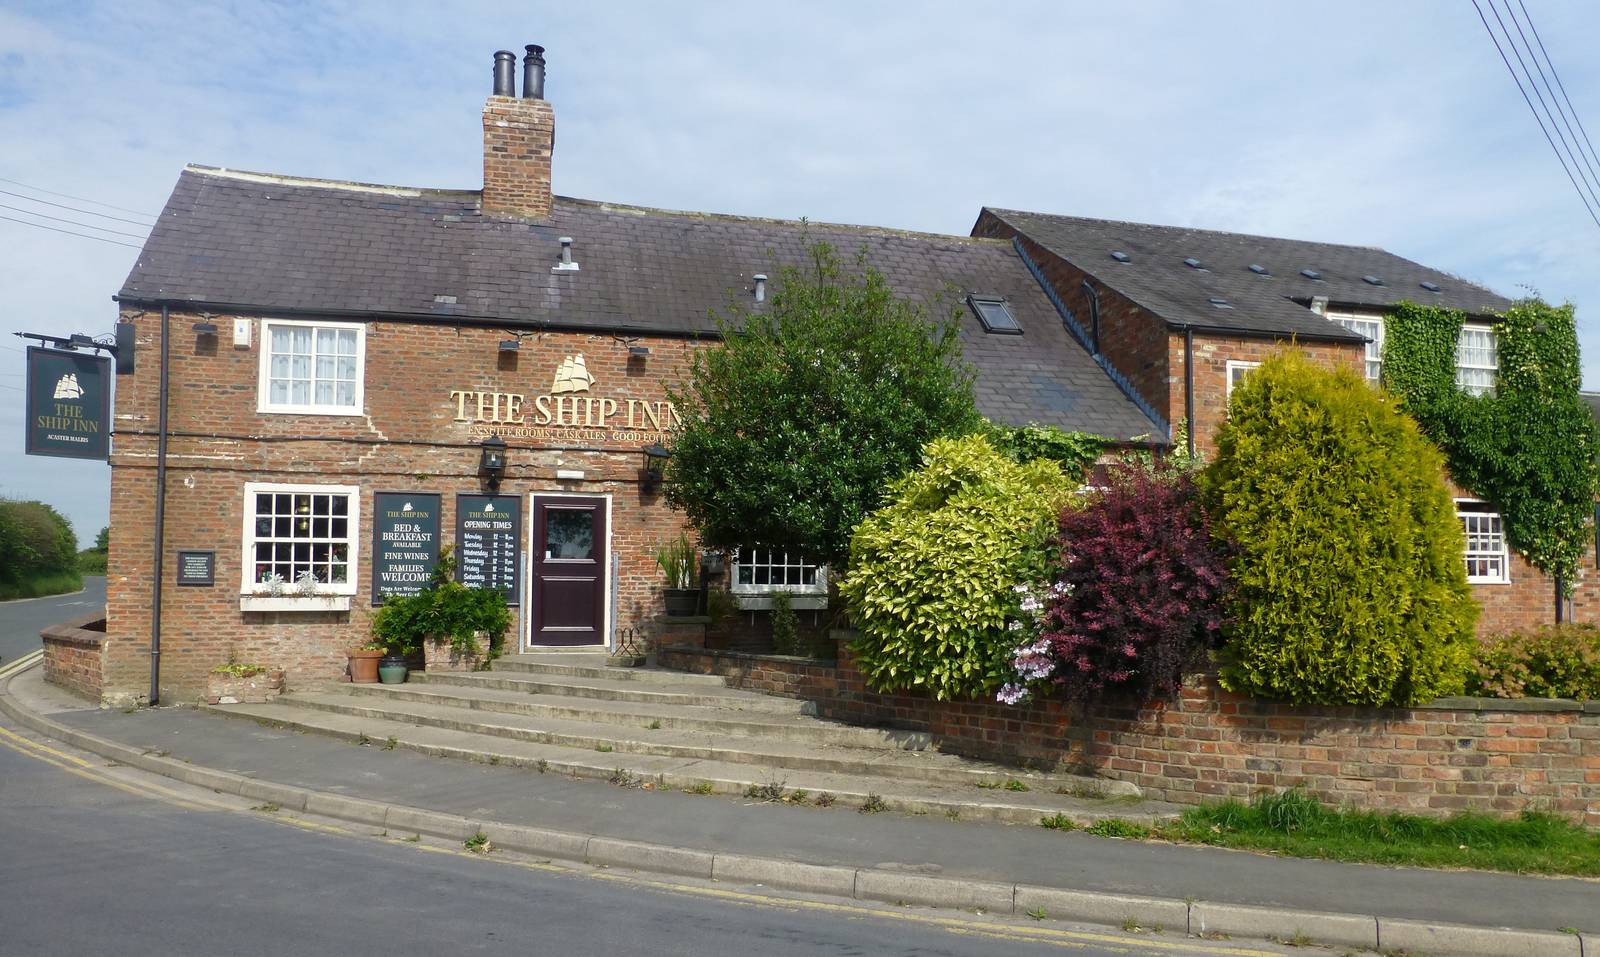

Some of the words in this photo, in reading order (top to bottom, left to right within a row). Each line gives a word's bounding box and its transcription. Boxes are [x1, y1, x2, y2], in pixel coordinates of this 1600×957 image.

[54, 403, 84, 418] THE
[449, 390, 524, 424] THE
[535, 395, 618, 428] SHIP
[623, 399, 684, 433] INN
[38, 416, 70, 431] SHIP
[72, 418, 99, 433] INN
[556, 430, 582, 440] CASK
[583, 431, 607, 441] ALES
[612, 431, 641, 442] GOOD
[643, 432, 670, 443] FOOD
[401, 511, 417, 519] SHIP
[417, 511, 430, 519] INN
[482, 511, 498, 519] SHIP
[498, 512, 510, 520] INN
[394, 523, 412, 532] BED
[413, 524, 421, 533] &
[464, 520, 491, 529] OPENING
[493, 521, 513, 529] TIMES
[382, 532, 432, 541] BREAKFAST
[464, 532, 483, 541] Monday
[464, 540, 483, 549] Tuesday
[384, 552, 403, 560] FINE
[404, 552, 429, 560] WINES
[463, 549, 489, 558] Wednesday
[463, 556, 485, 566] Thursday
[389, 564, 425, 572] FAMILIES
[464, 565, 480, 574] Friday
[381, 572, 432, 582] WELCOME
[463, 573, 486, 581] Saturday
